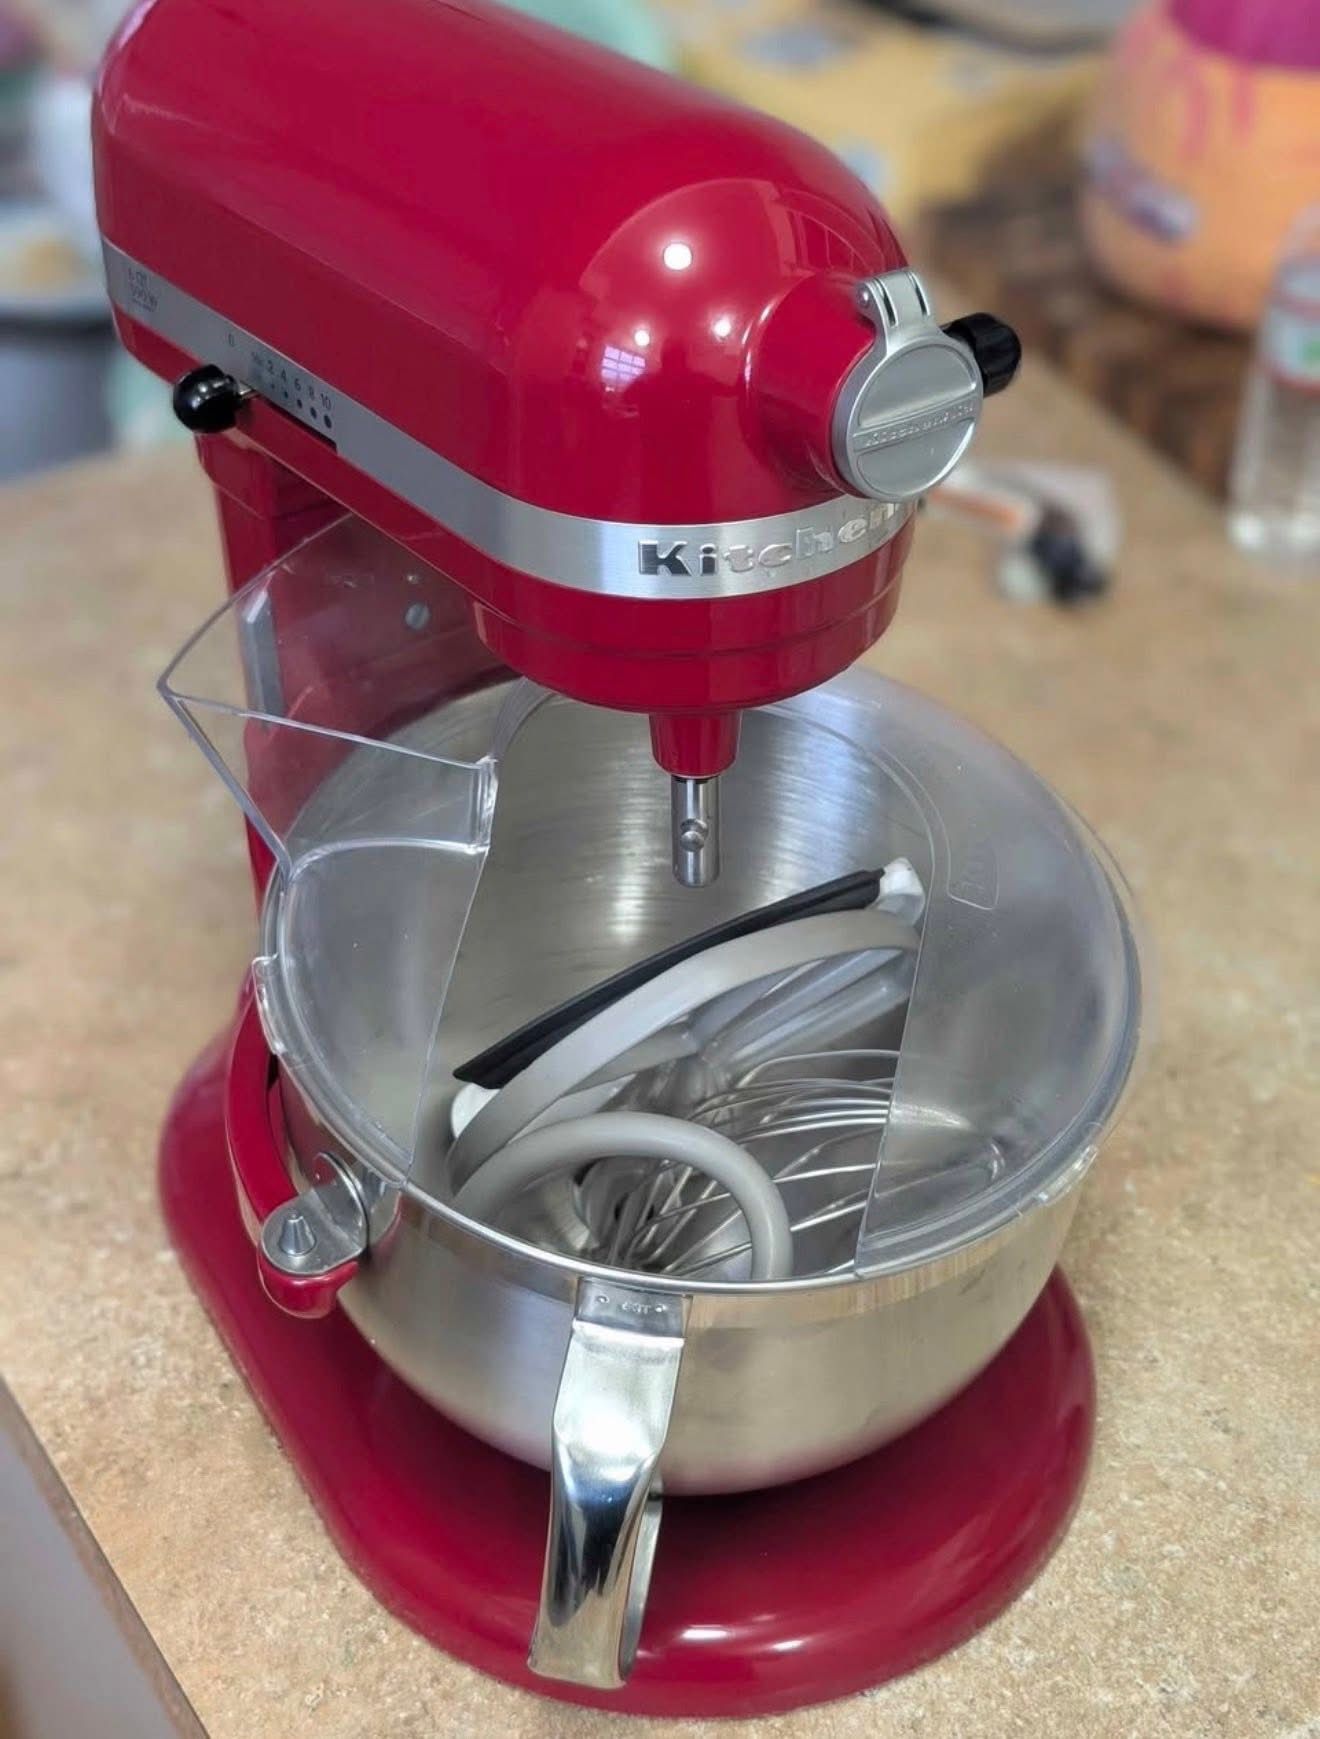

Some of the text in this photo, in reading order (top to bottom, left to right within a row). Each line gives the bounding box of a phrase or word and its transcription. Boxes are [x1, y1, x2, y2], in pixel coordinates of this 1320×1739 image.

[281, 369, 288, 382] 4
[294, 377, 302, 391] 6
[320, 392, 332, 410] 10
